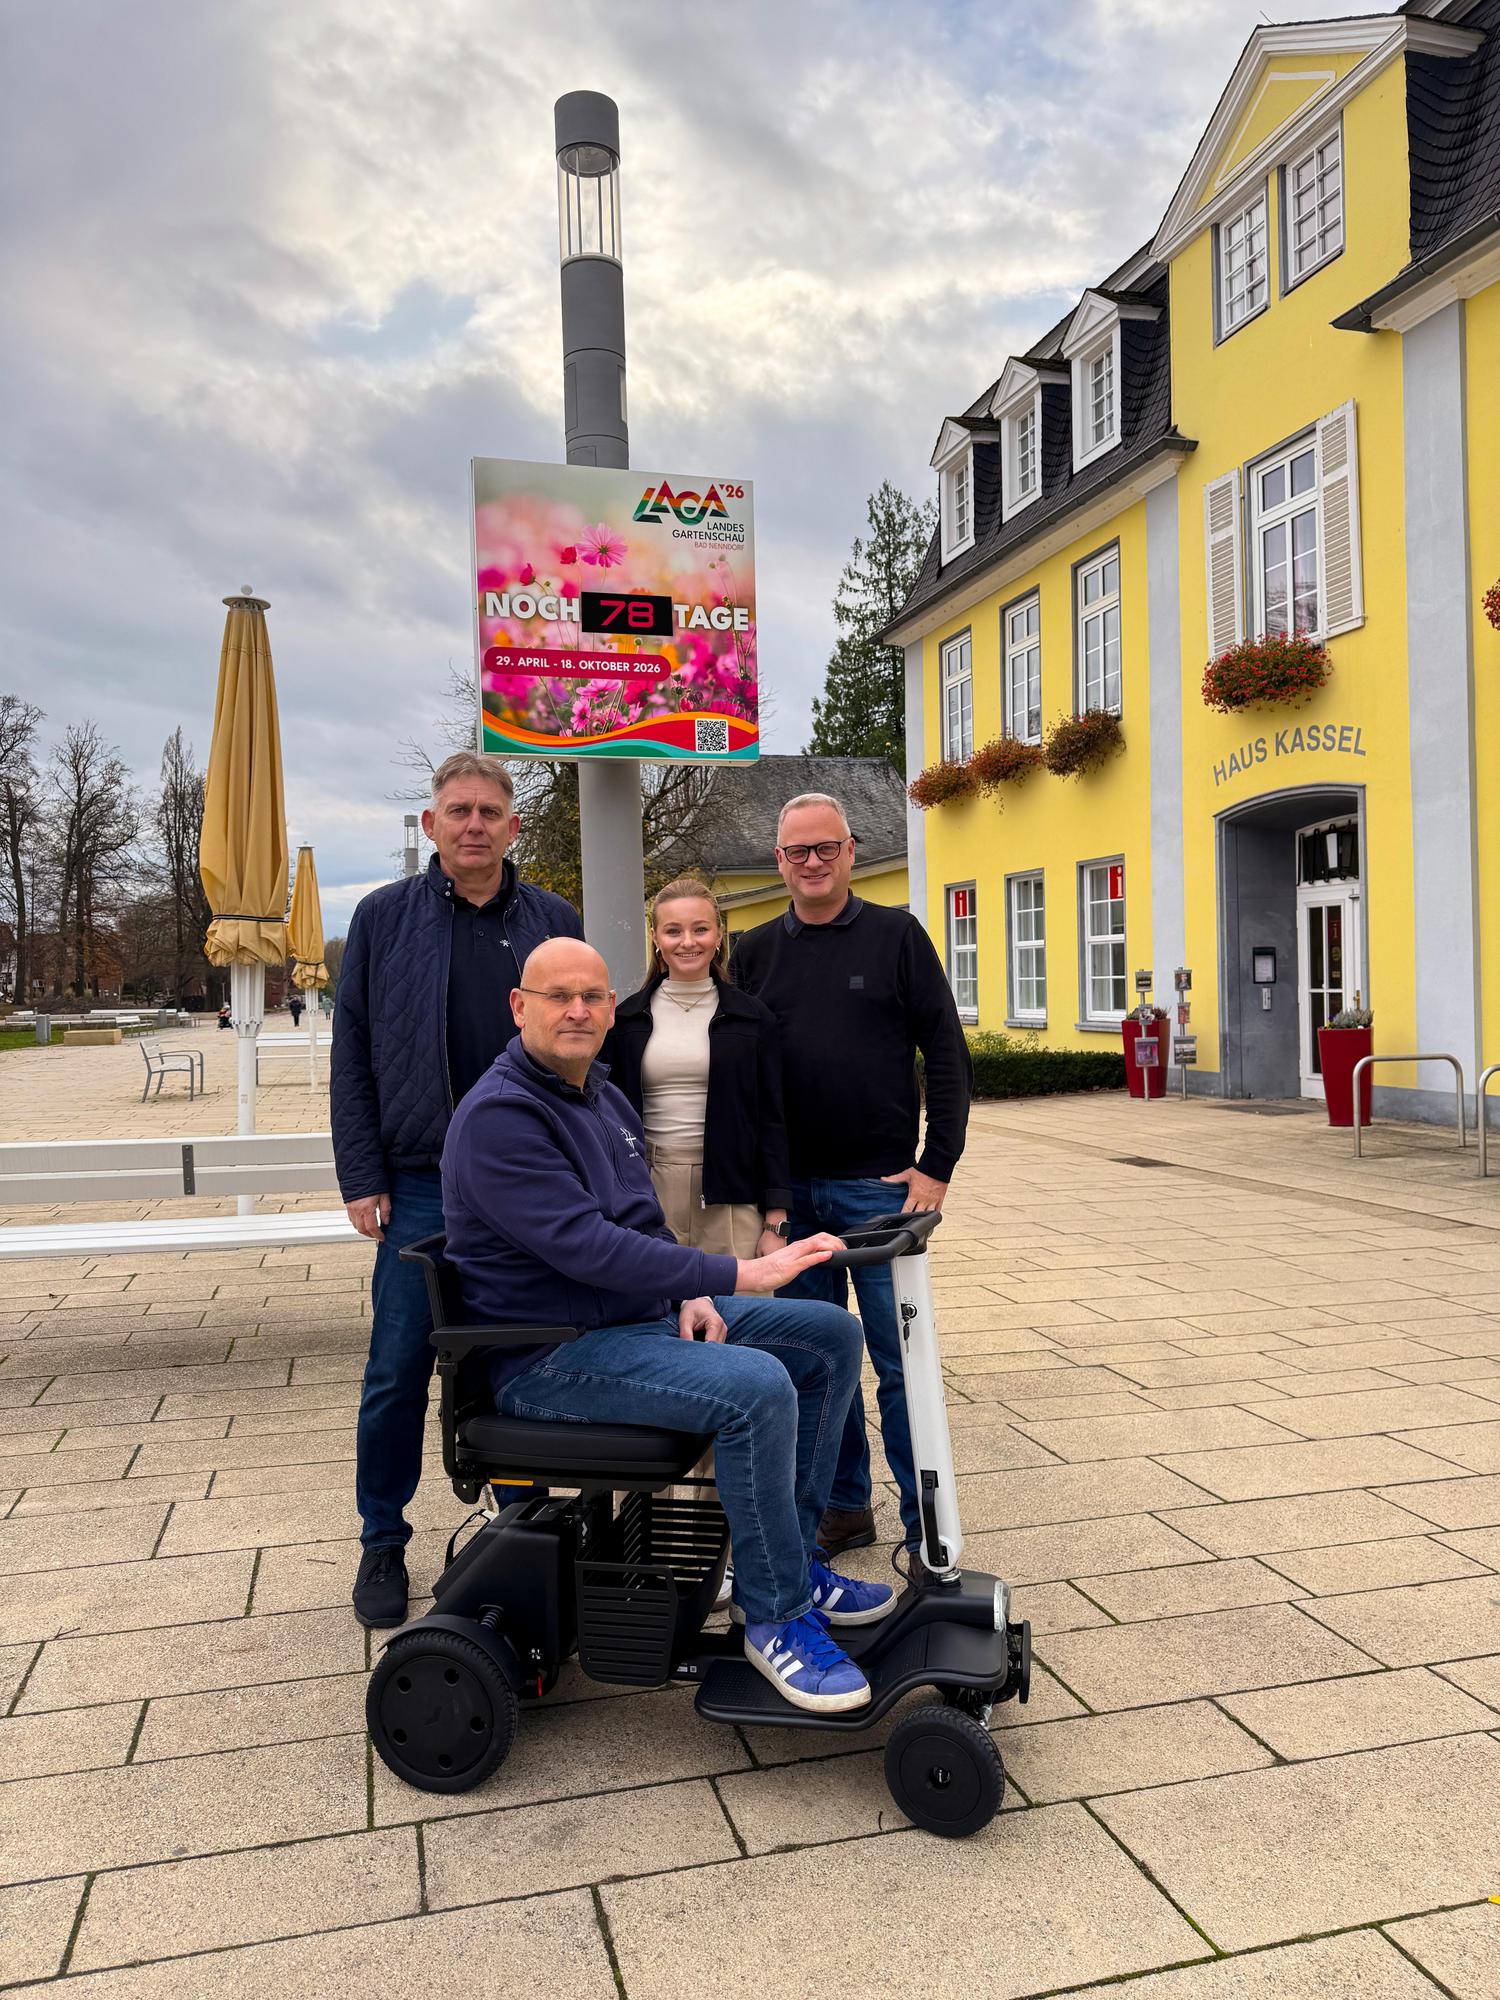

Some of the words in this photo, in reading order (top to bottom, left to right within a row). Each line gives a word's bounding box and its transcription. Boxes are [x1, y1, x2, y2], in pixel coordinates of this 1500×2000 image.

[632, 480, 730, 526] LAGA
[672, 529, 745, 543] GARTENSCHAU
[707, 522, 745, 533] LANDES
[708, 543, 745, 551] NENNDORF
[485, 591, 580, 622] NOCH
[600, 600, 654, 628] 78
[673, 604, 749, 631] TAGE
[495, 655, 514, 666] 29.
[517, 657, 550, 668] APRIL
[560, 659, 576, 669] 18.
[579, 660, 630, 672] OKTOBER
[633, 663, 661, 673] 2026
[1213, 737, 1267, 786] HAUS
[1275, 724, 1367, 756] KASSEL
